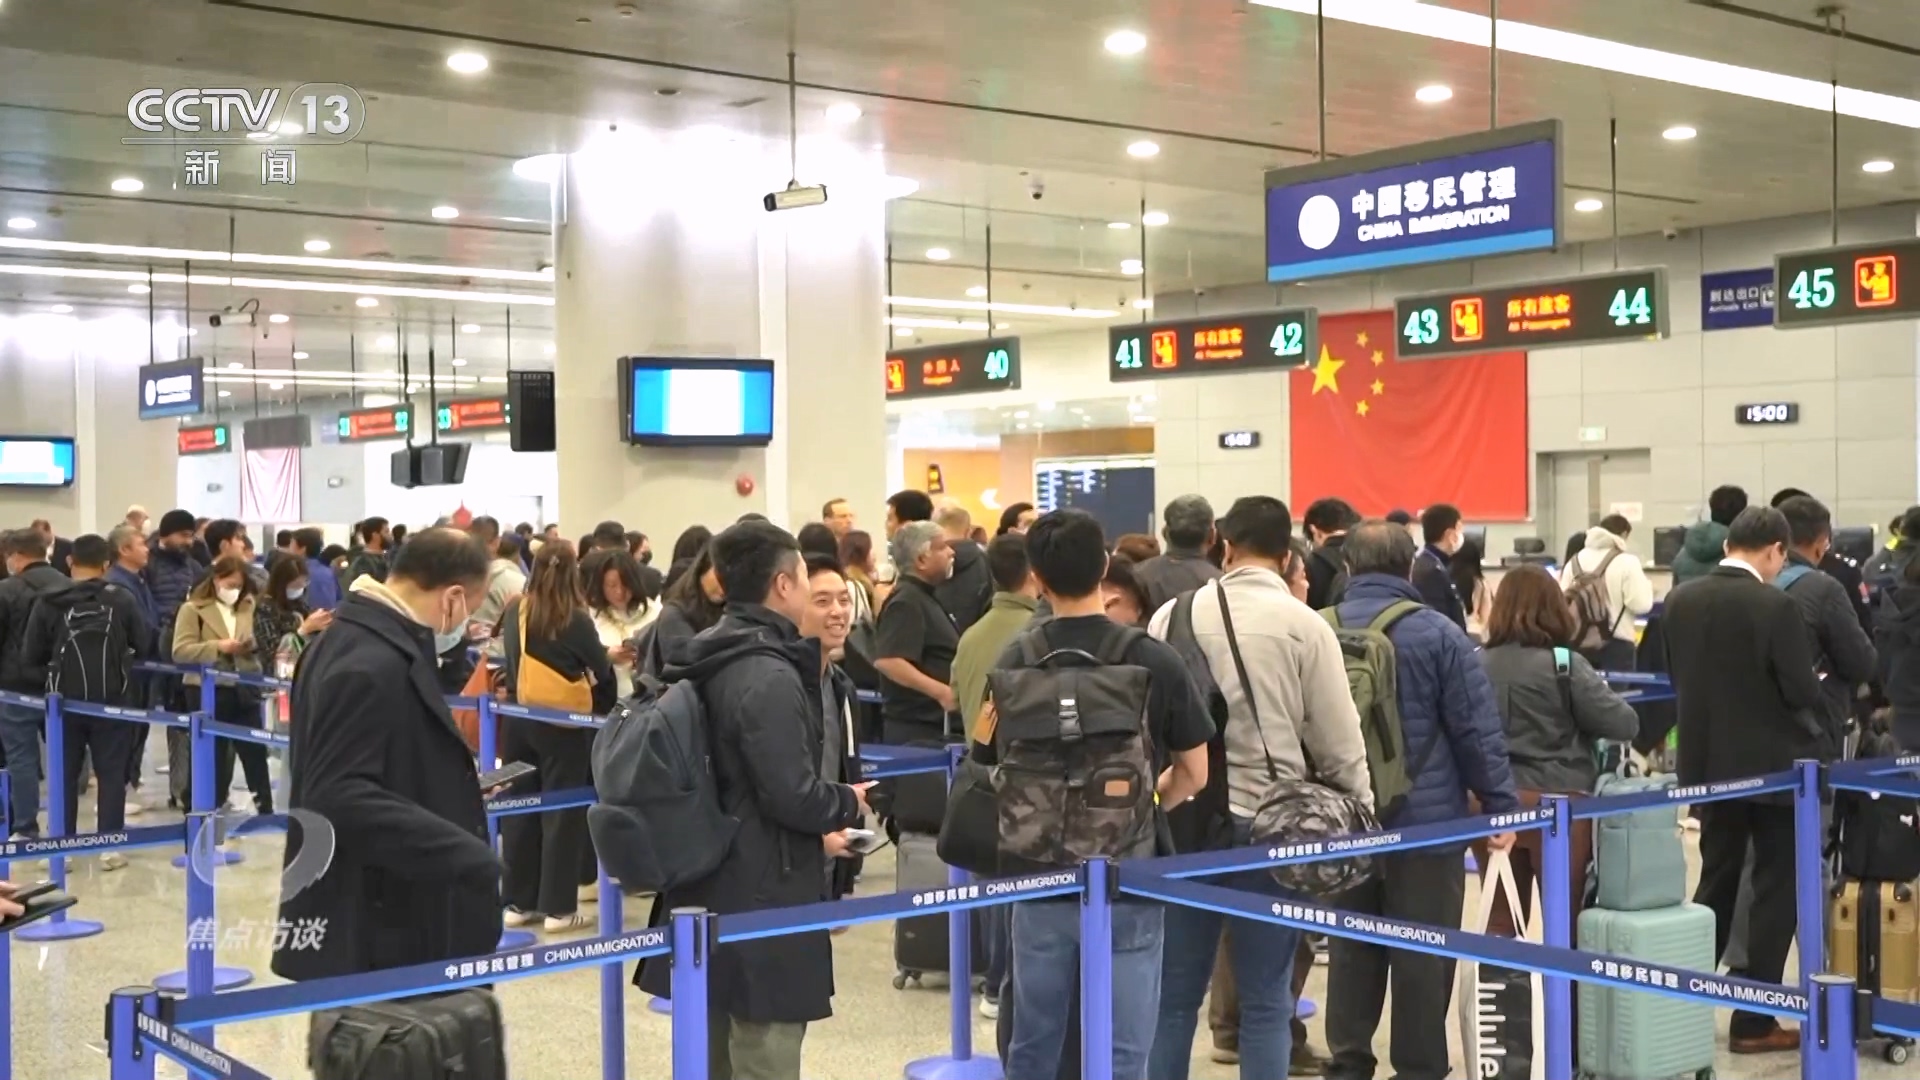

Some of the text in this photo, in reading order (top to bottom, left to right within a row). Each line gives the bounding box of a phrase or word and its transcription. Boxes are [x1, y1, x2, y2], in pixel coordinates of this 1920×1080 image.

[1352, 166, 1516, 221] 中国移民管理
[1357, 204, 1510, 242] CHINA IMMIGRATION
[1788, 267, 1835, 309] 45
[1608, 287, 1650, 326] 44
[1270, 322, 1302, 356] 42
[1404, 308, 1439, 344] 43
[984, 349, 1009, 379] 40
[1115, 337, 1143, 368] 41
[1747, 404, 1787, 422] 15:00
[25, 833, 128, 852] CHINA IMMIGRATION
[1328, 833, 1402, 852] CHINA IMMIGRATION
[986, 873, 1076, 896] CHINA IMMIGRATION
[1344, 916, 1445, 946] CHINA IMMIGRATION
[544, 932, 664, 964] CHINA IMMIGRATION
[445, 953, 535, 980] 中国移民管理
[1591, 959, 1679, 989] 中国移民管理
[1689, 978, 1809, 1011] CHINA IMMIGRATI
